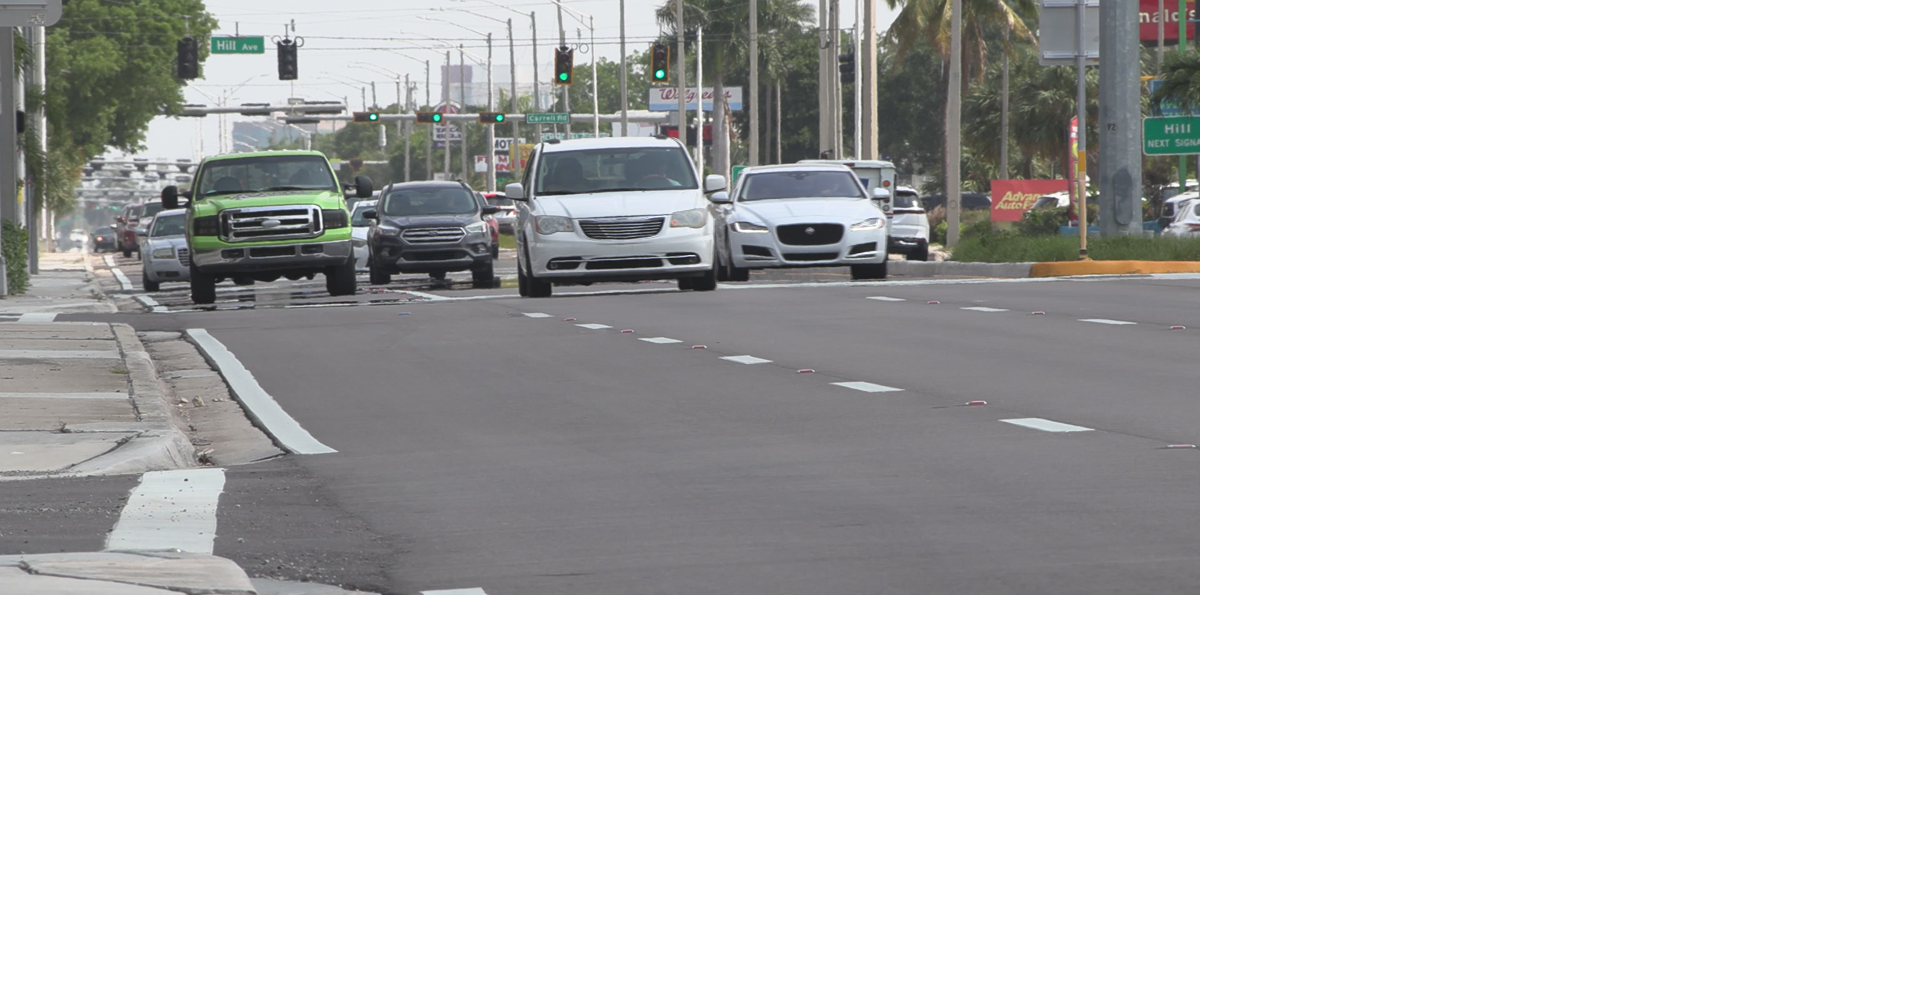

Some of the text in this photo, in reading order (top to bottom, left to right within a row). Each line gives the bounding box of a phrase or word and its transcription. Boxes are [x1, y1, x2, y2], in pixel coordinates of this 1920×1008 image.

[217, 40, 236, 51] Hill
[1164, 123, 1191, 134] Hill
[1147, 139, 1170, 148] NEXT
[995, 201, 1023, 210] Auto
